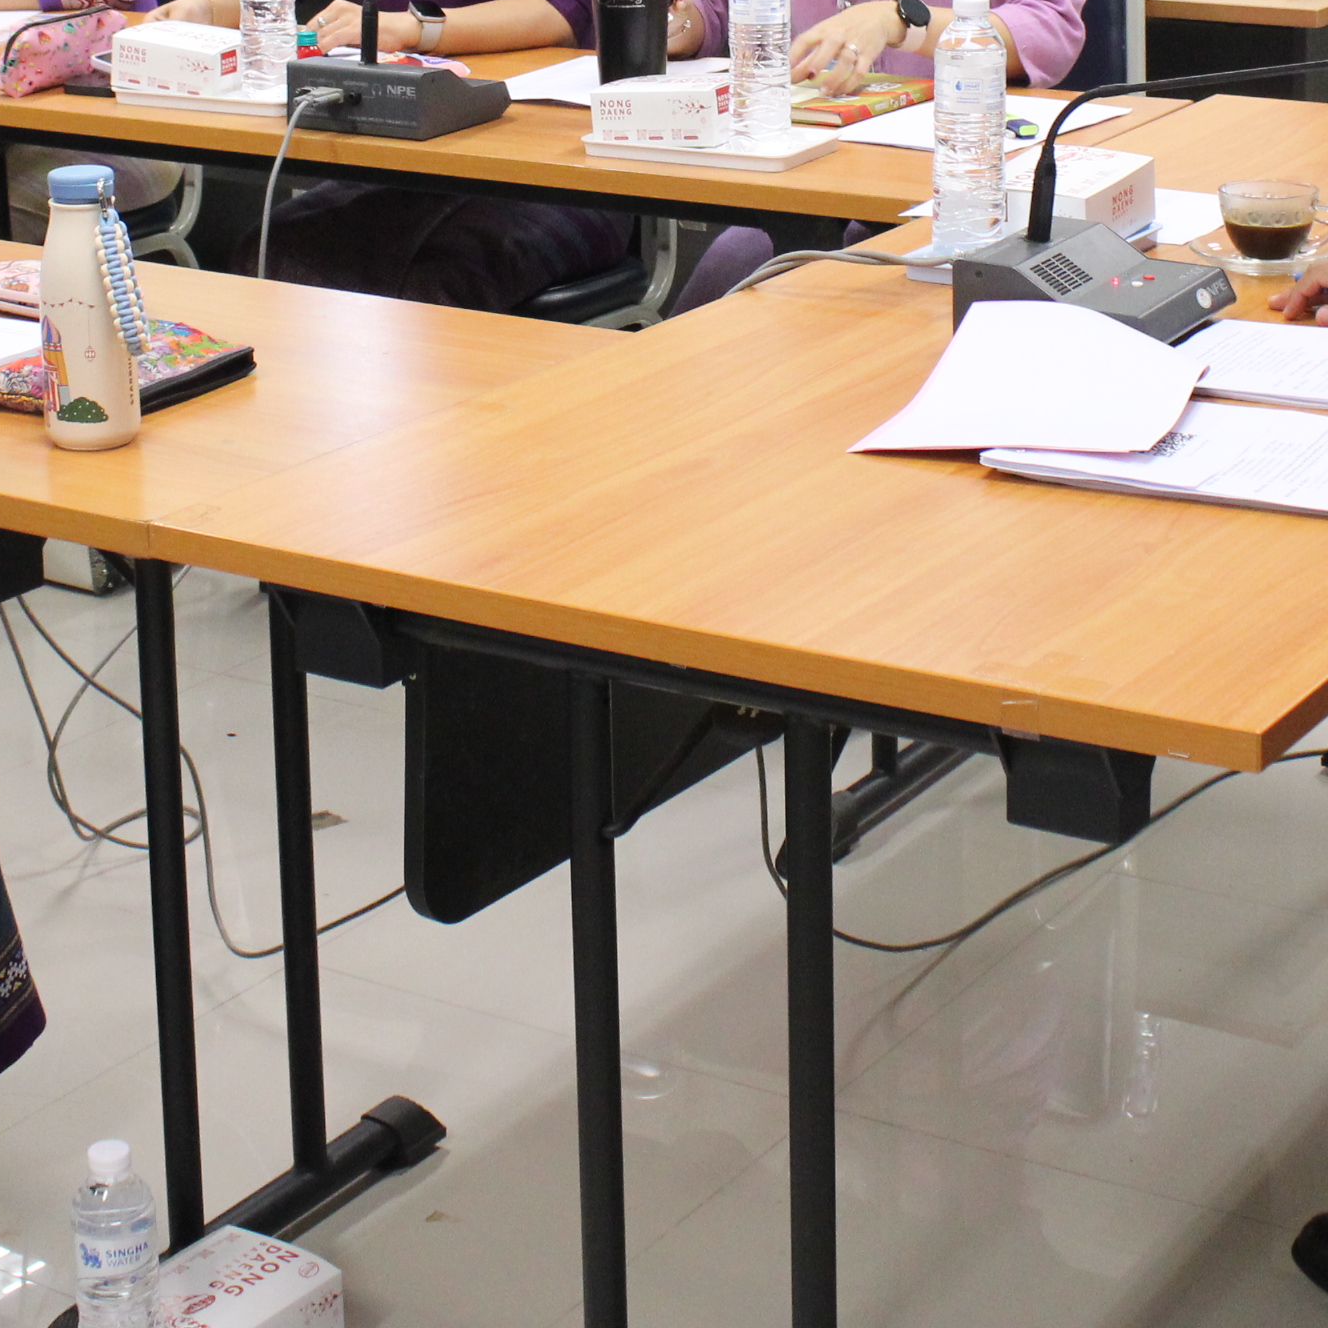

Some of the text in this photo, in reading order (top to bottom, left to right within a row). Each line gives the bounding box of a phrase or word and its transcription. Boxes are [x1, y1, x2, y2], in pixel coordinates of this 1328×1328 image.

[118, 52, 147, 64] DAENG
[119, 44, 147, 56] NONG
[386, 84, 416, 97] NPE
[600, 100, 632, 108] NONG
[1112, 184, 1134, 204] NONG
[1112, 195, 1134, 215] DAENG
[1206, 278, 1228, 296] NPE
[105, 1242, 148, 1258] SINGHA
[106, 1254, 141, 1267] WATER
[209, 1244, 283, 1289] DAENG
[224, 1250, 300, 1296] NONG
